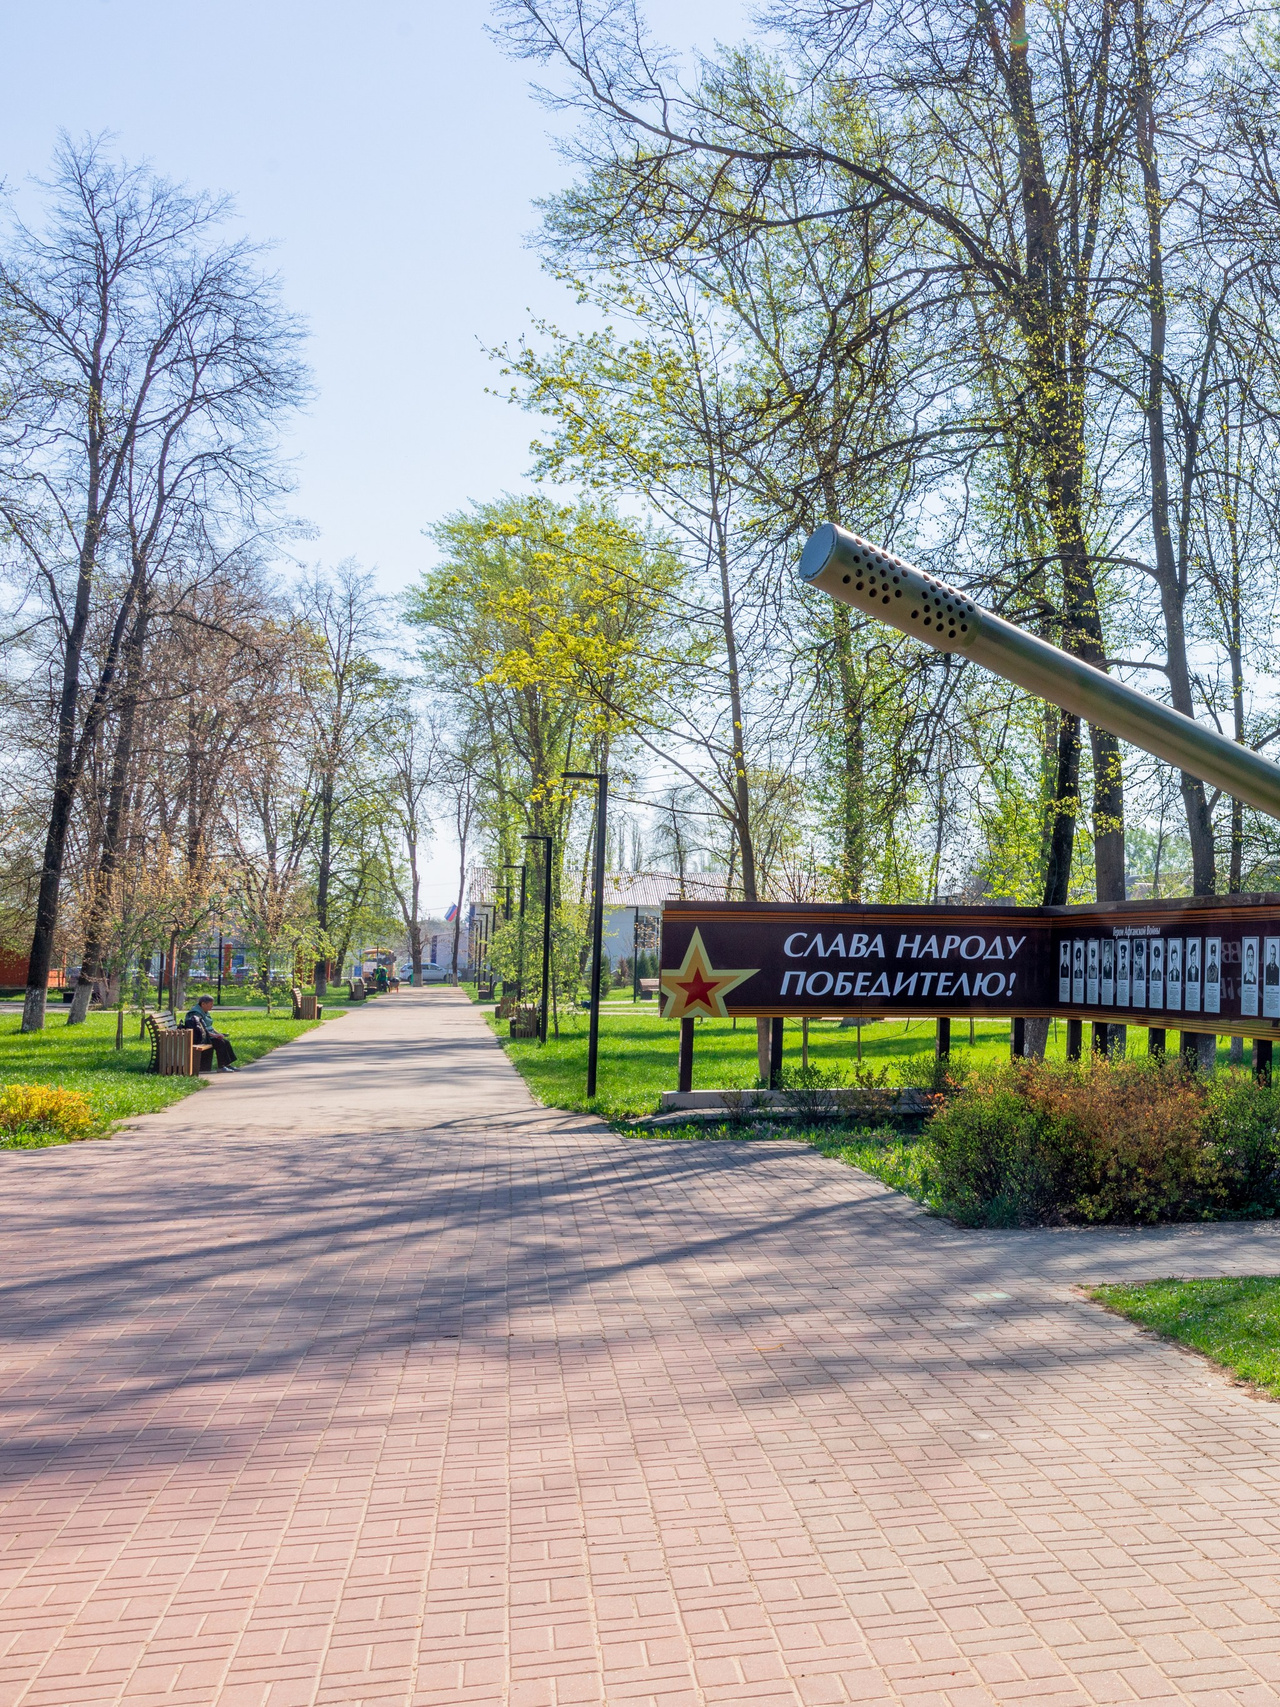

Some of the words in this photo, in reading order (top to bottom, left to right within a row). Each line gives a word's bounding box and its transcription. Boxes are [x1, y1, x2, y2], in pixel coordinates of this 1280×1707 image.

[783, 932, 885, 958] СЛАВА
[896, 934, 1026, 960] НАРОДУ
[780, 971, 1017, 997] ПОБЕДИТЕЛЮ!
